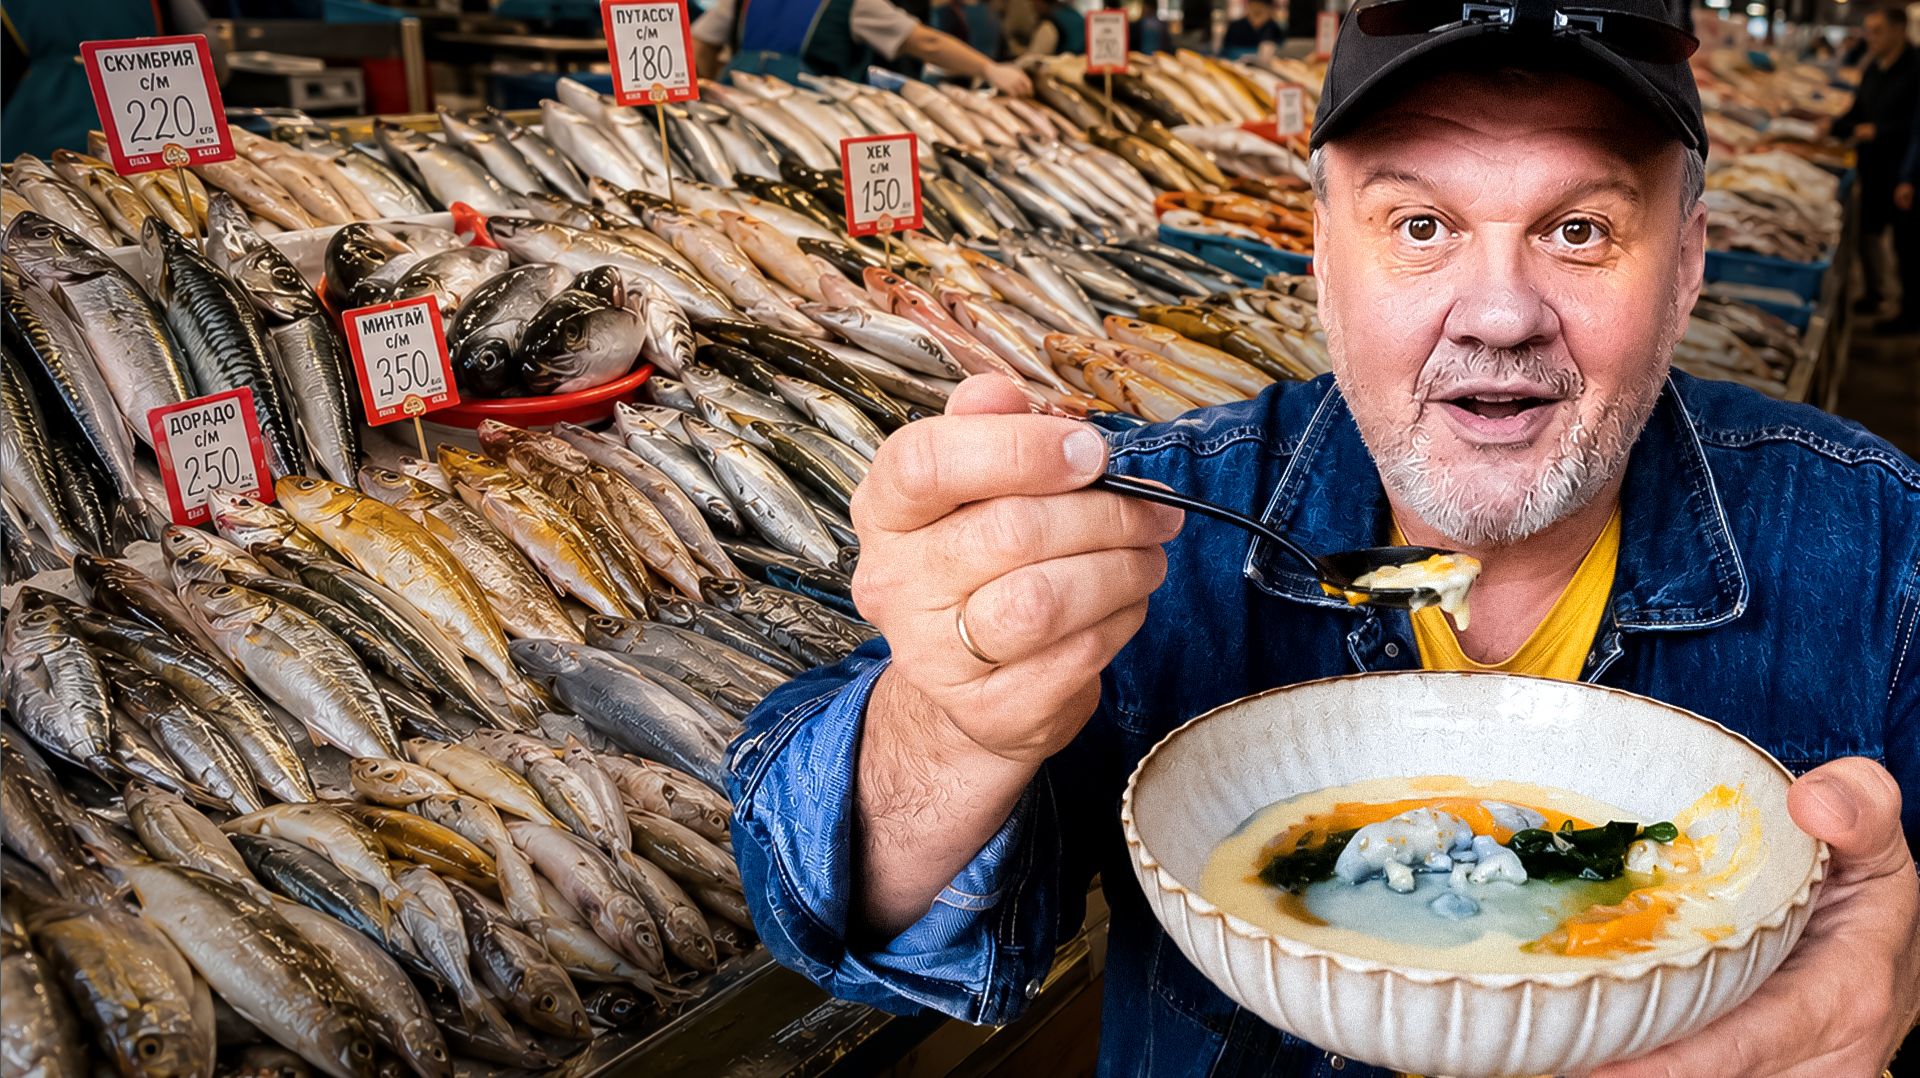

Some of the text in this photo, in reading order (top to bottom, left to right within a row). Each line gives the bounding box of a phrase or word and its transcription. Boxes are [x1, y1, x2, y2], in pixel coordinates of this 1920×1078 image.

[616, 8, 674, 24] ПУТАССУ
[104, 50, 194, 72] СКУМБРИЯ
[629, 45, 673, 82] 180
[127, 95, 195, 143] 220
[866, 144, 891, 159] ХЕК
[862, 178, 901, 213] 150
[362, 307, 424, 335] МИНТАЙ
[376, 350, 429, 396] 350
[170, 403, 235, 436] ДОРАДО
[184, 446, 240, 496] 250
